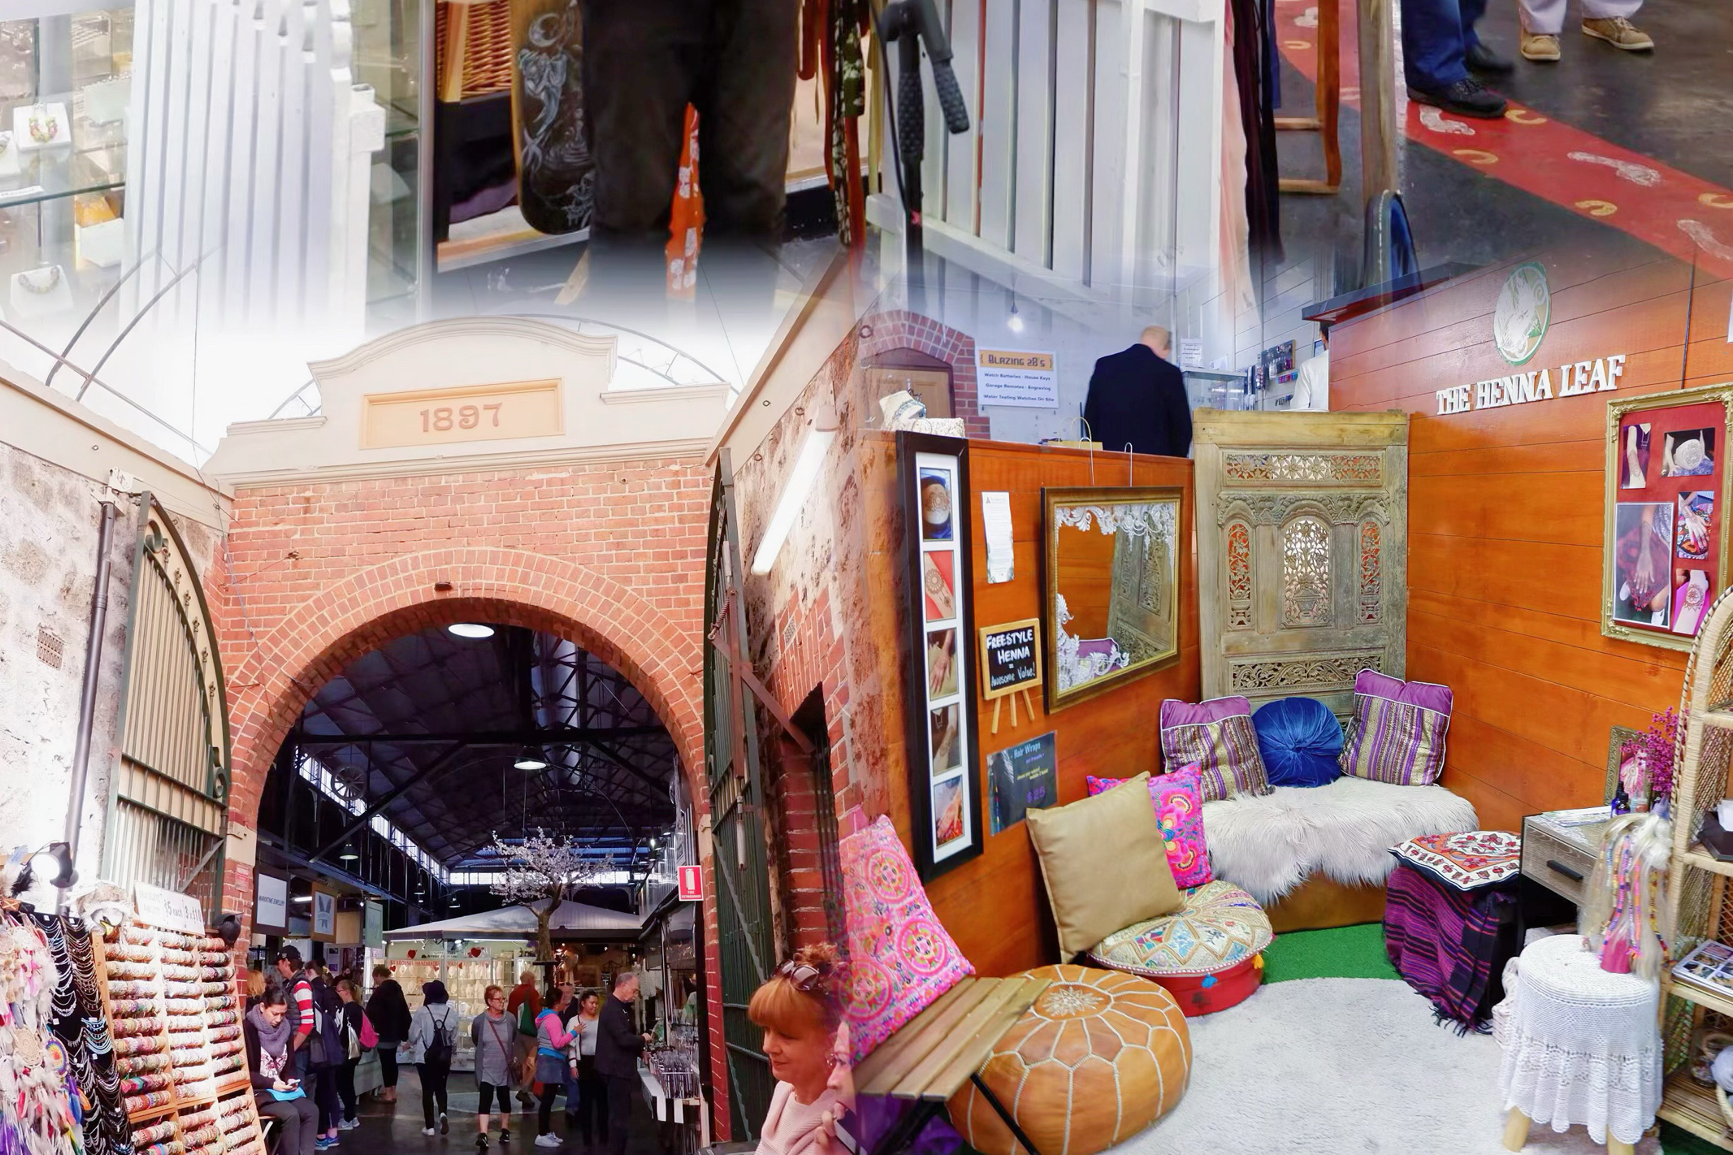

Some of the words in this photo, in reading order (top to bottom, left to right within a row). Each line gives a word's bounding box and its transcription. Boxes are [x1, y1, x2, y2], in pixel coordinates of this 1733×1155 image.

[988, 354, 1025, 366] BLAZING
[1435, 384, 1471, 416] THE
[1475, 368, 1554, 410] HENNA
[1558, 354, 1626, 398] LEAF
[420, 401, 503, 433] 1897
[986, 628, 1034, 650] FREESTYLE
[997, 645, 1031, 665] HENNA
[1024, 742, 1041, 755] Wraps
